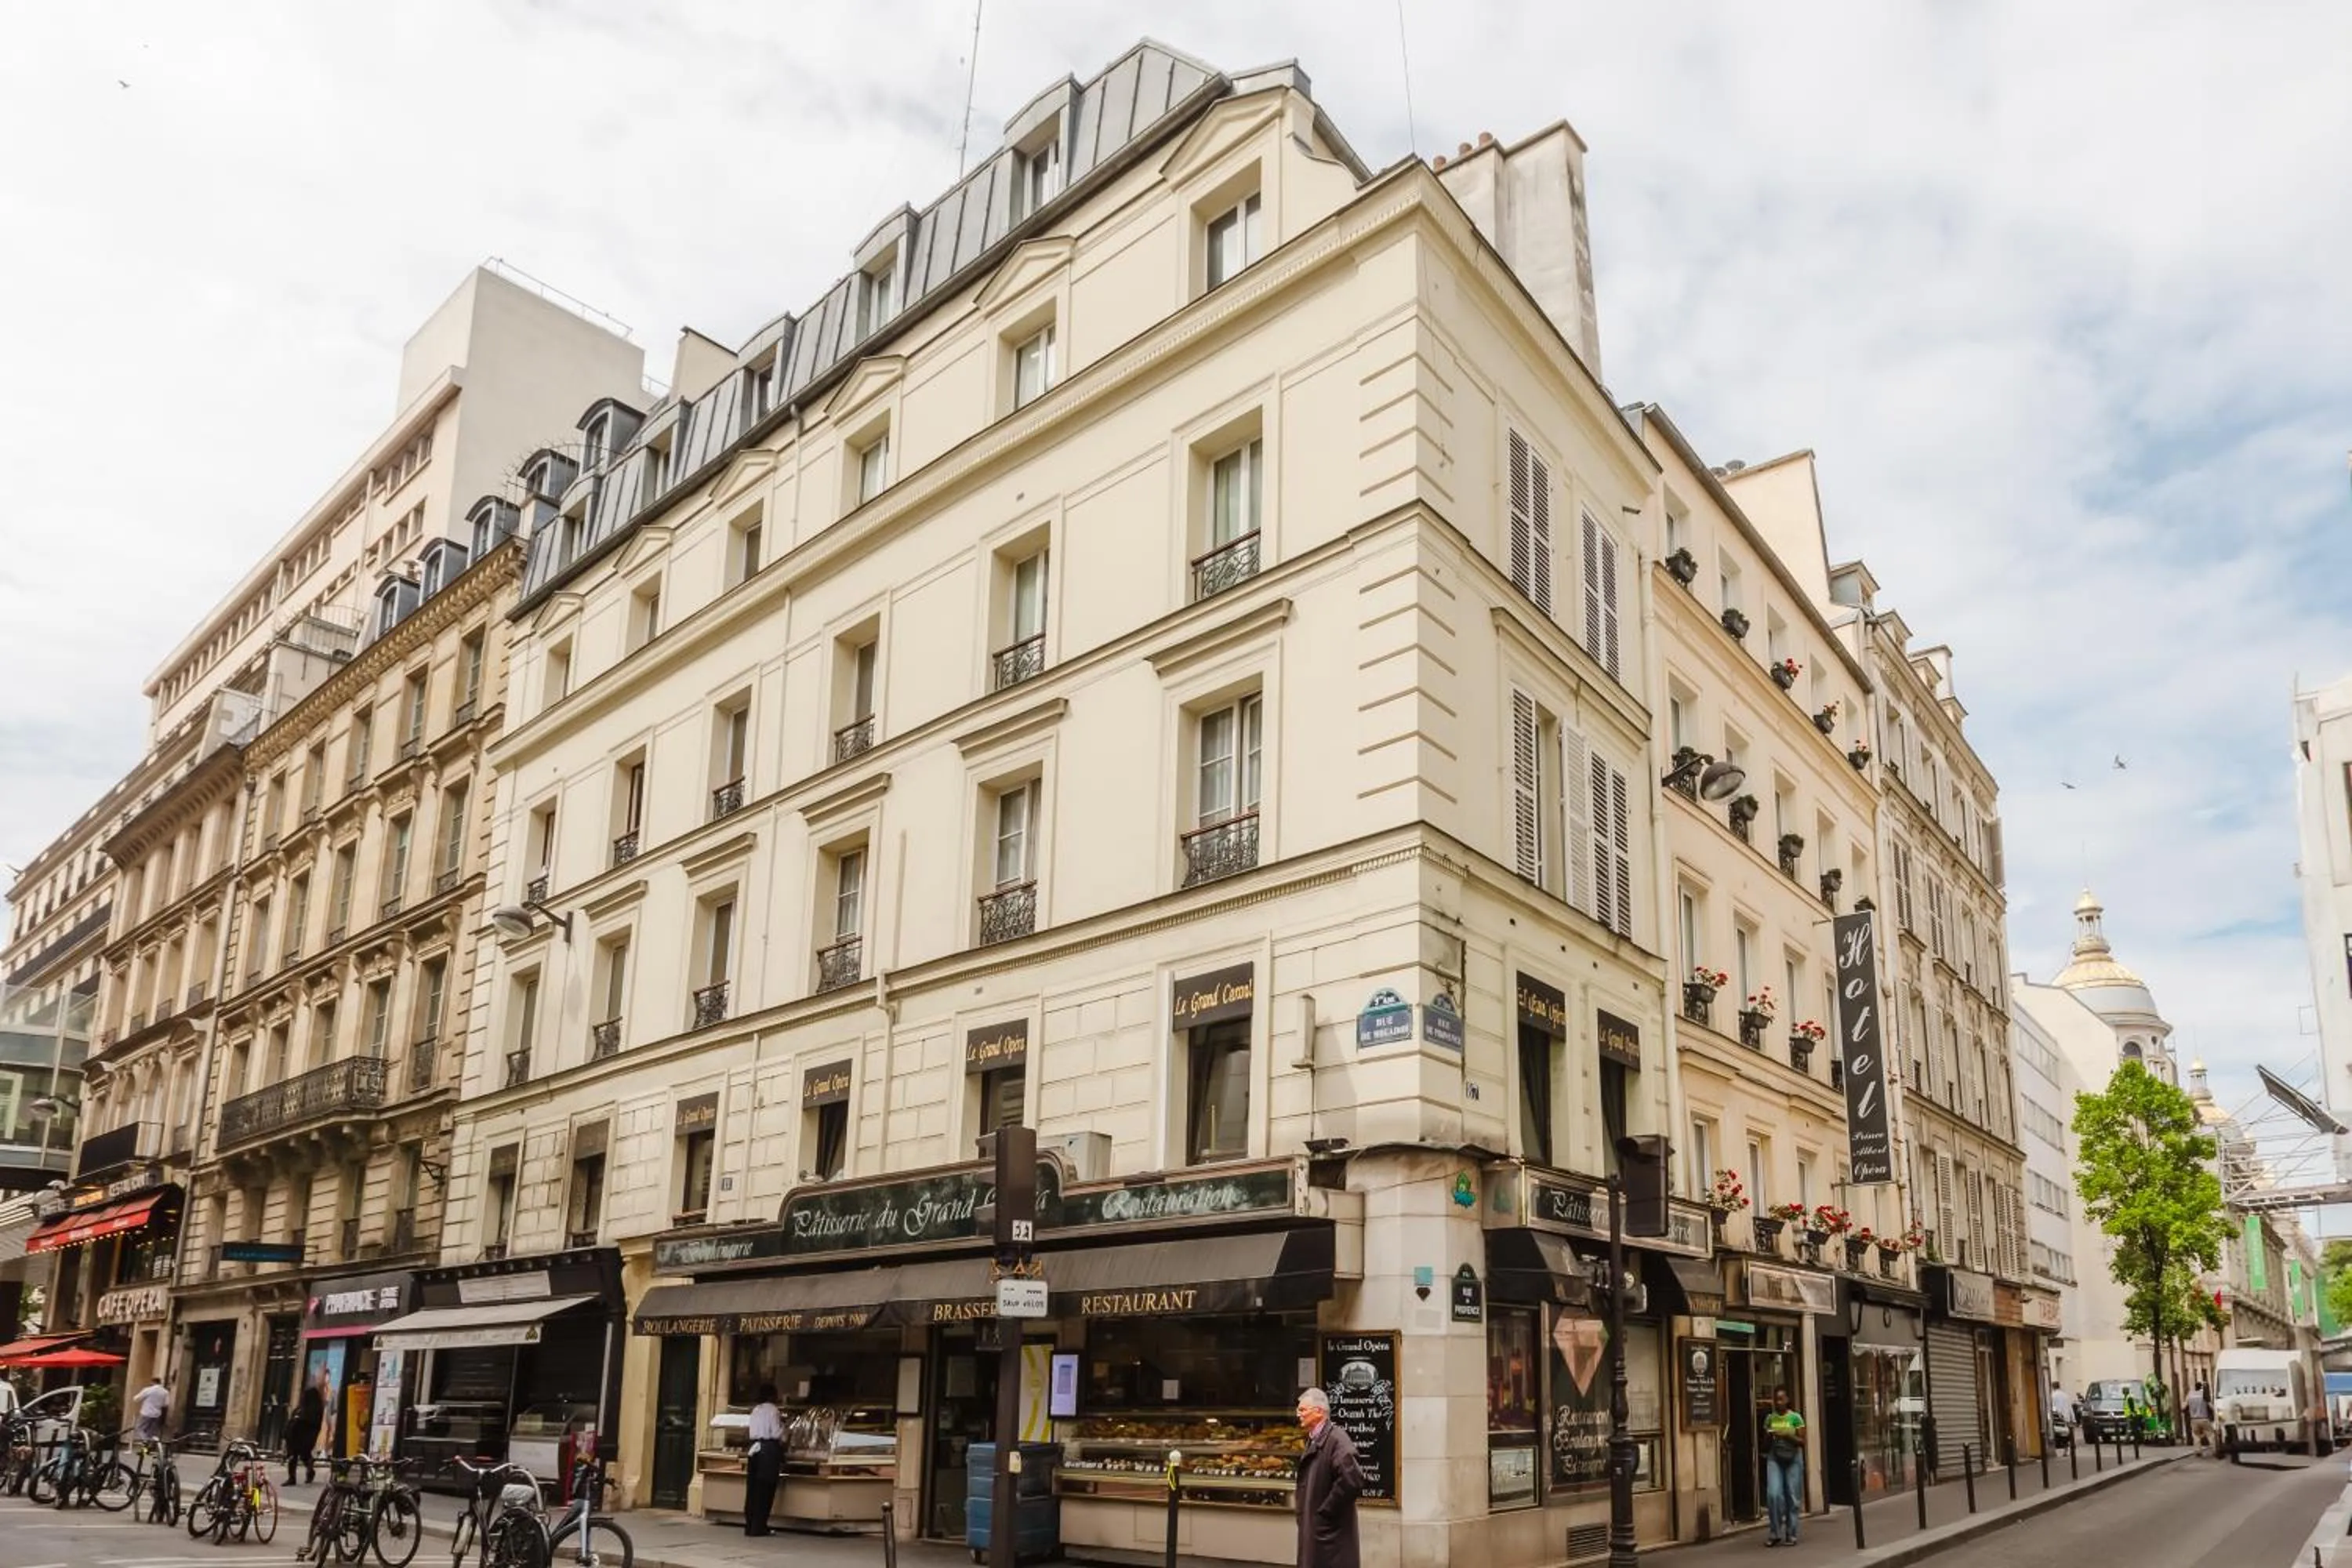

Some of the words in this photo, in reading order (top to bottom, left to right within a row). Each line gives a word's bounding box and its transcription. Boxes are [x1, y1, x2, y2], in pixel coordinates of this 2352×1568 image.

[1839, 922, 1876, 1119] Hotel
[793, 1209, 871, 1237] Pâtisserie
[874, 1200, 898, 1229] du
[904, 1189, 978, 1236] Grand
[1082, 1290, 1197, 1315] RESTAURANT
[642, 1318, 717, 1334] BOULANGERIE
